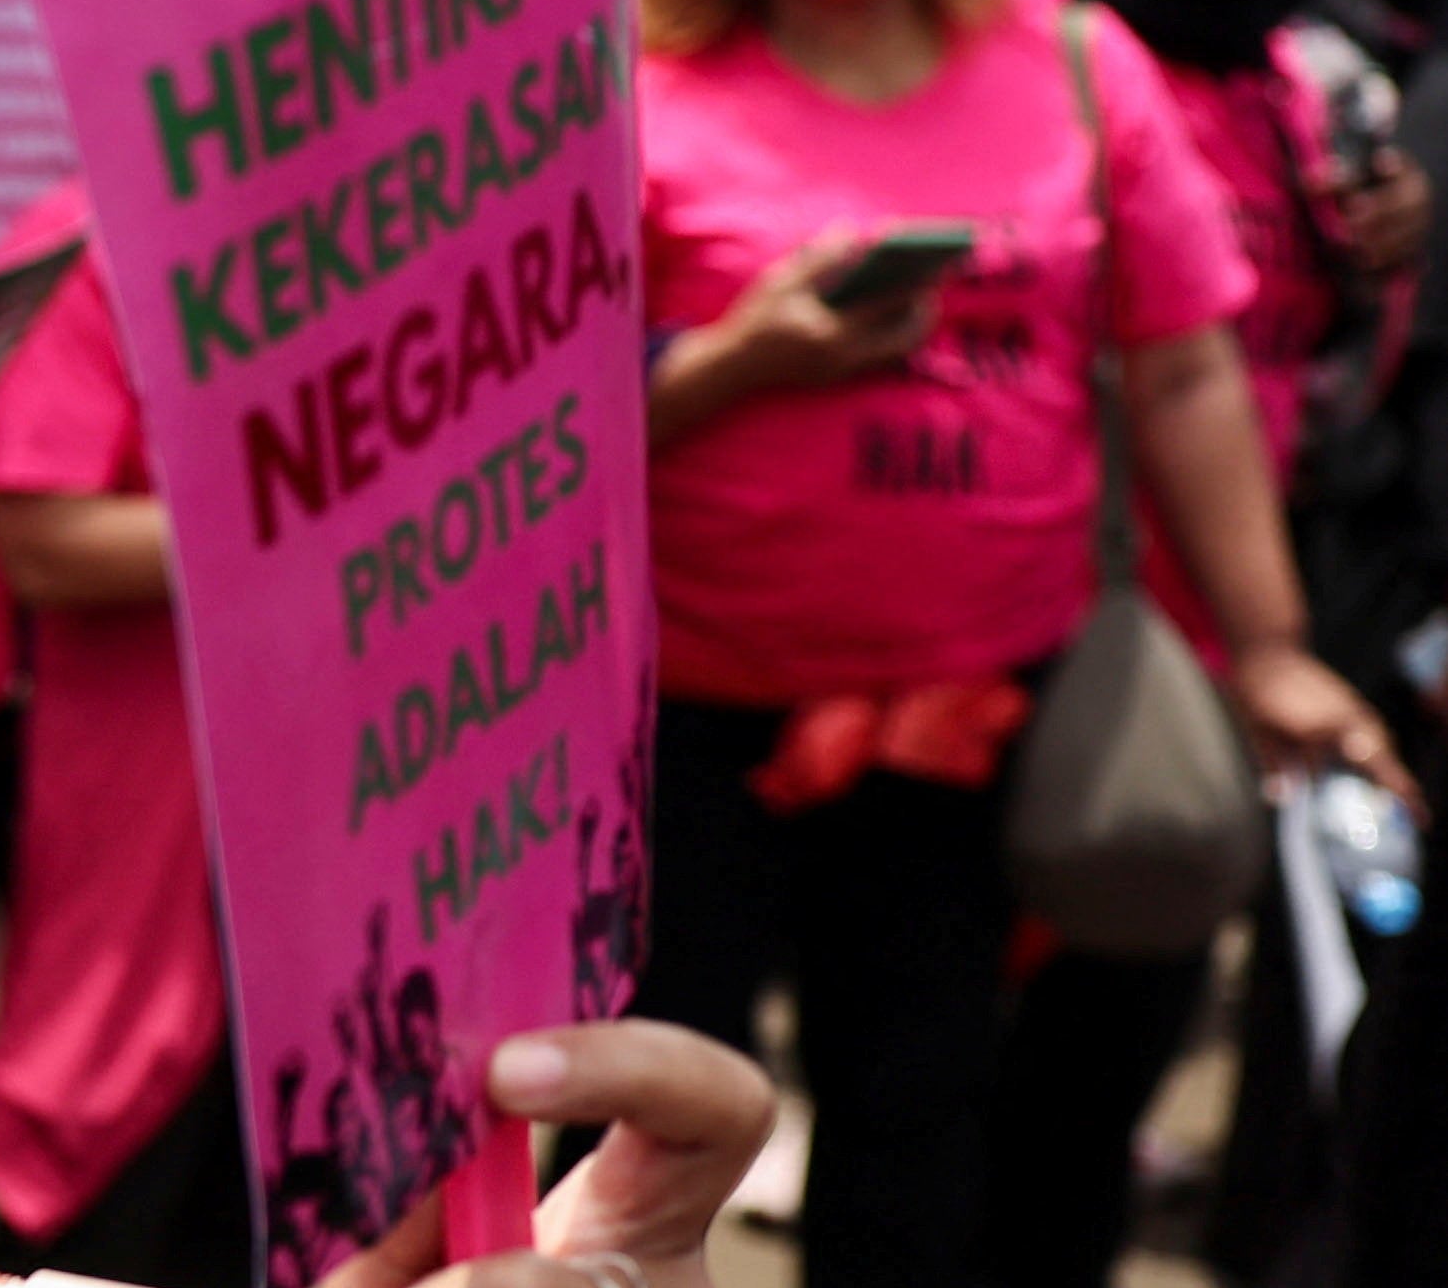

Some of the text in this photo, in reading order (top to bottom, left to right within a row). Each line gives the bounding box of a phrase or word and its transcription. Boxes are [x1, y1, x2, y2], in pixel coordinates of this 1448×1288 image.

[169, 3, 631, 384] KEKERASAN
[240, 189, 628, 548] NEGARA,
[337, 393, 590, 660] PROTES
[348, 541, 612, 836] ADALAH
[413, 730, 573, 943] HAK!
